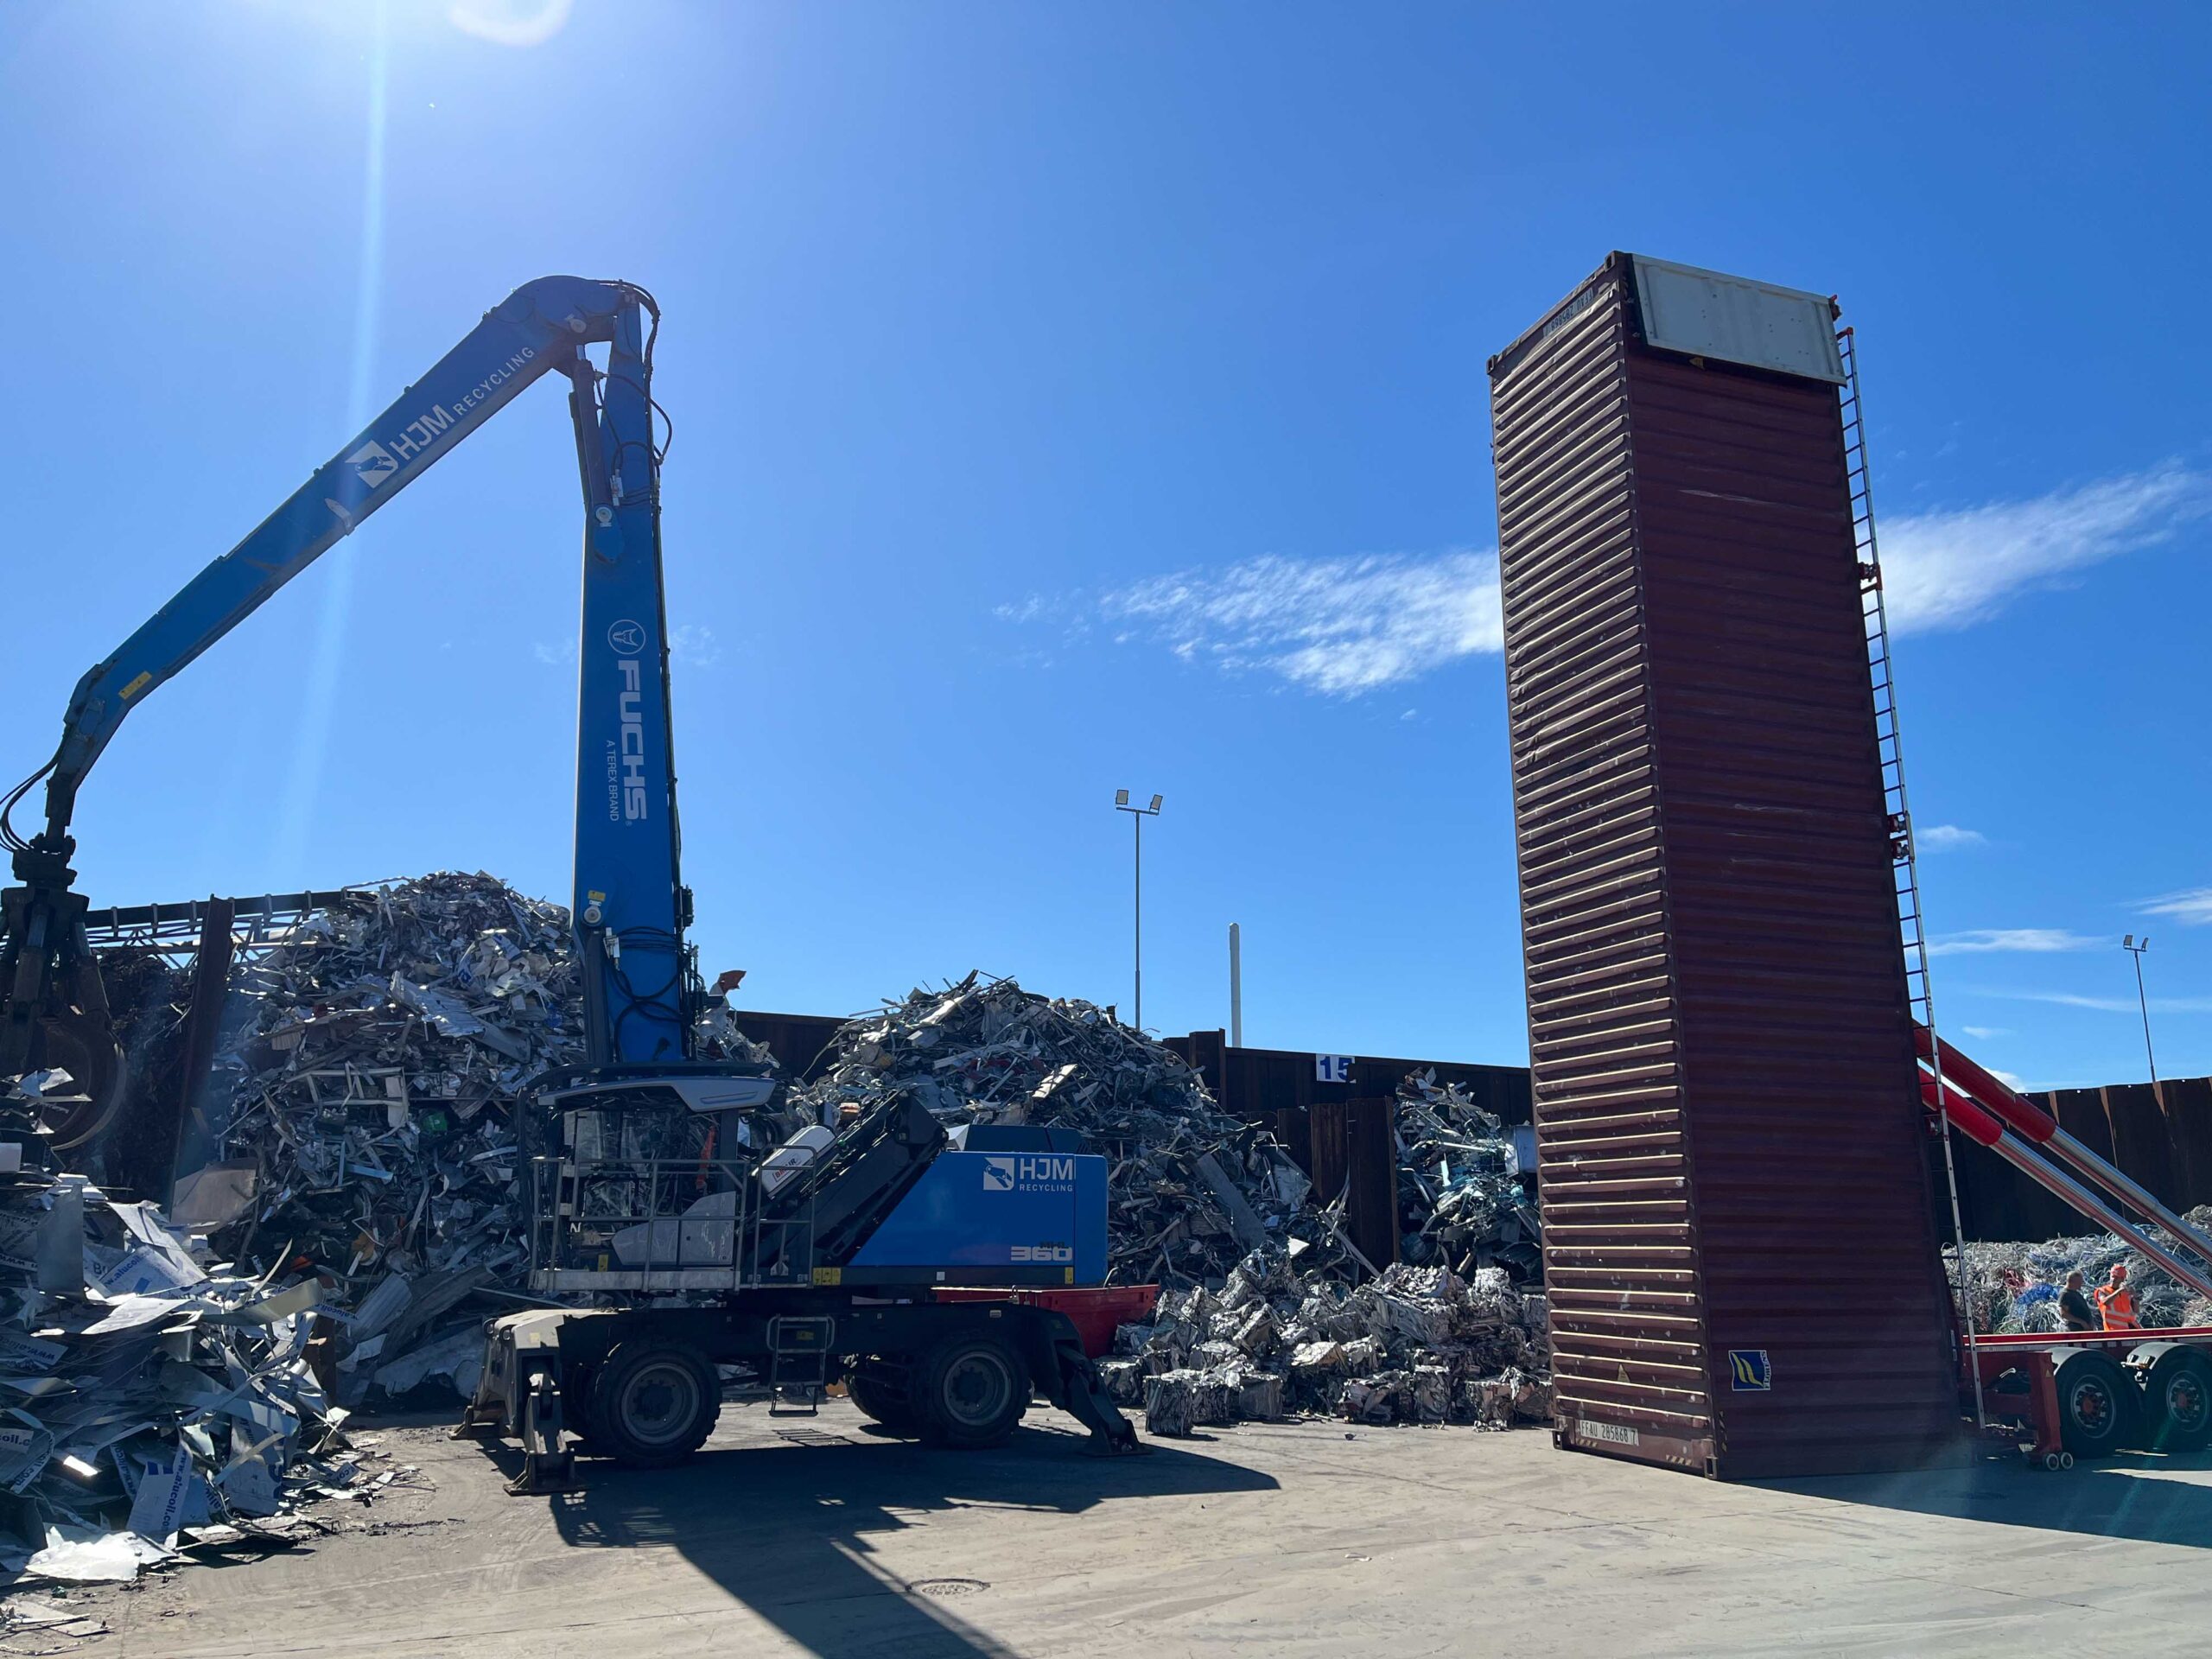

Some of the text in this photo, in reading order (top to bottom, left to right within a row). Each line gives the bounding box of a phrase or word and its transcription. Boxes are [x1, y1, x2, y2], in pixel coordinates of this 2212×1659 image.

[389, 346, 535, 461] HJM RECYCLING
[618, 659, 647, 820] FUCHS
[607, 751, 618, 783] TEREX
[608, 785, 620, 821] BRAND
[1019, 1157, 1073, 1181] HJM
[1019, 1183, 1073, 1192] RECYCLING
[1011, 1246, 1073, 1262] 360
[1581, 1421, 1636, 1445] FFAU 285868 7
